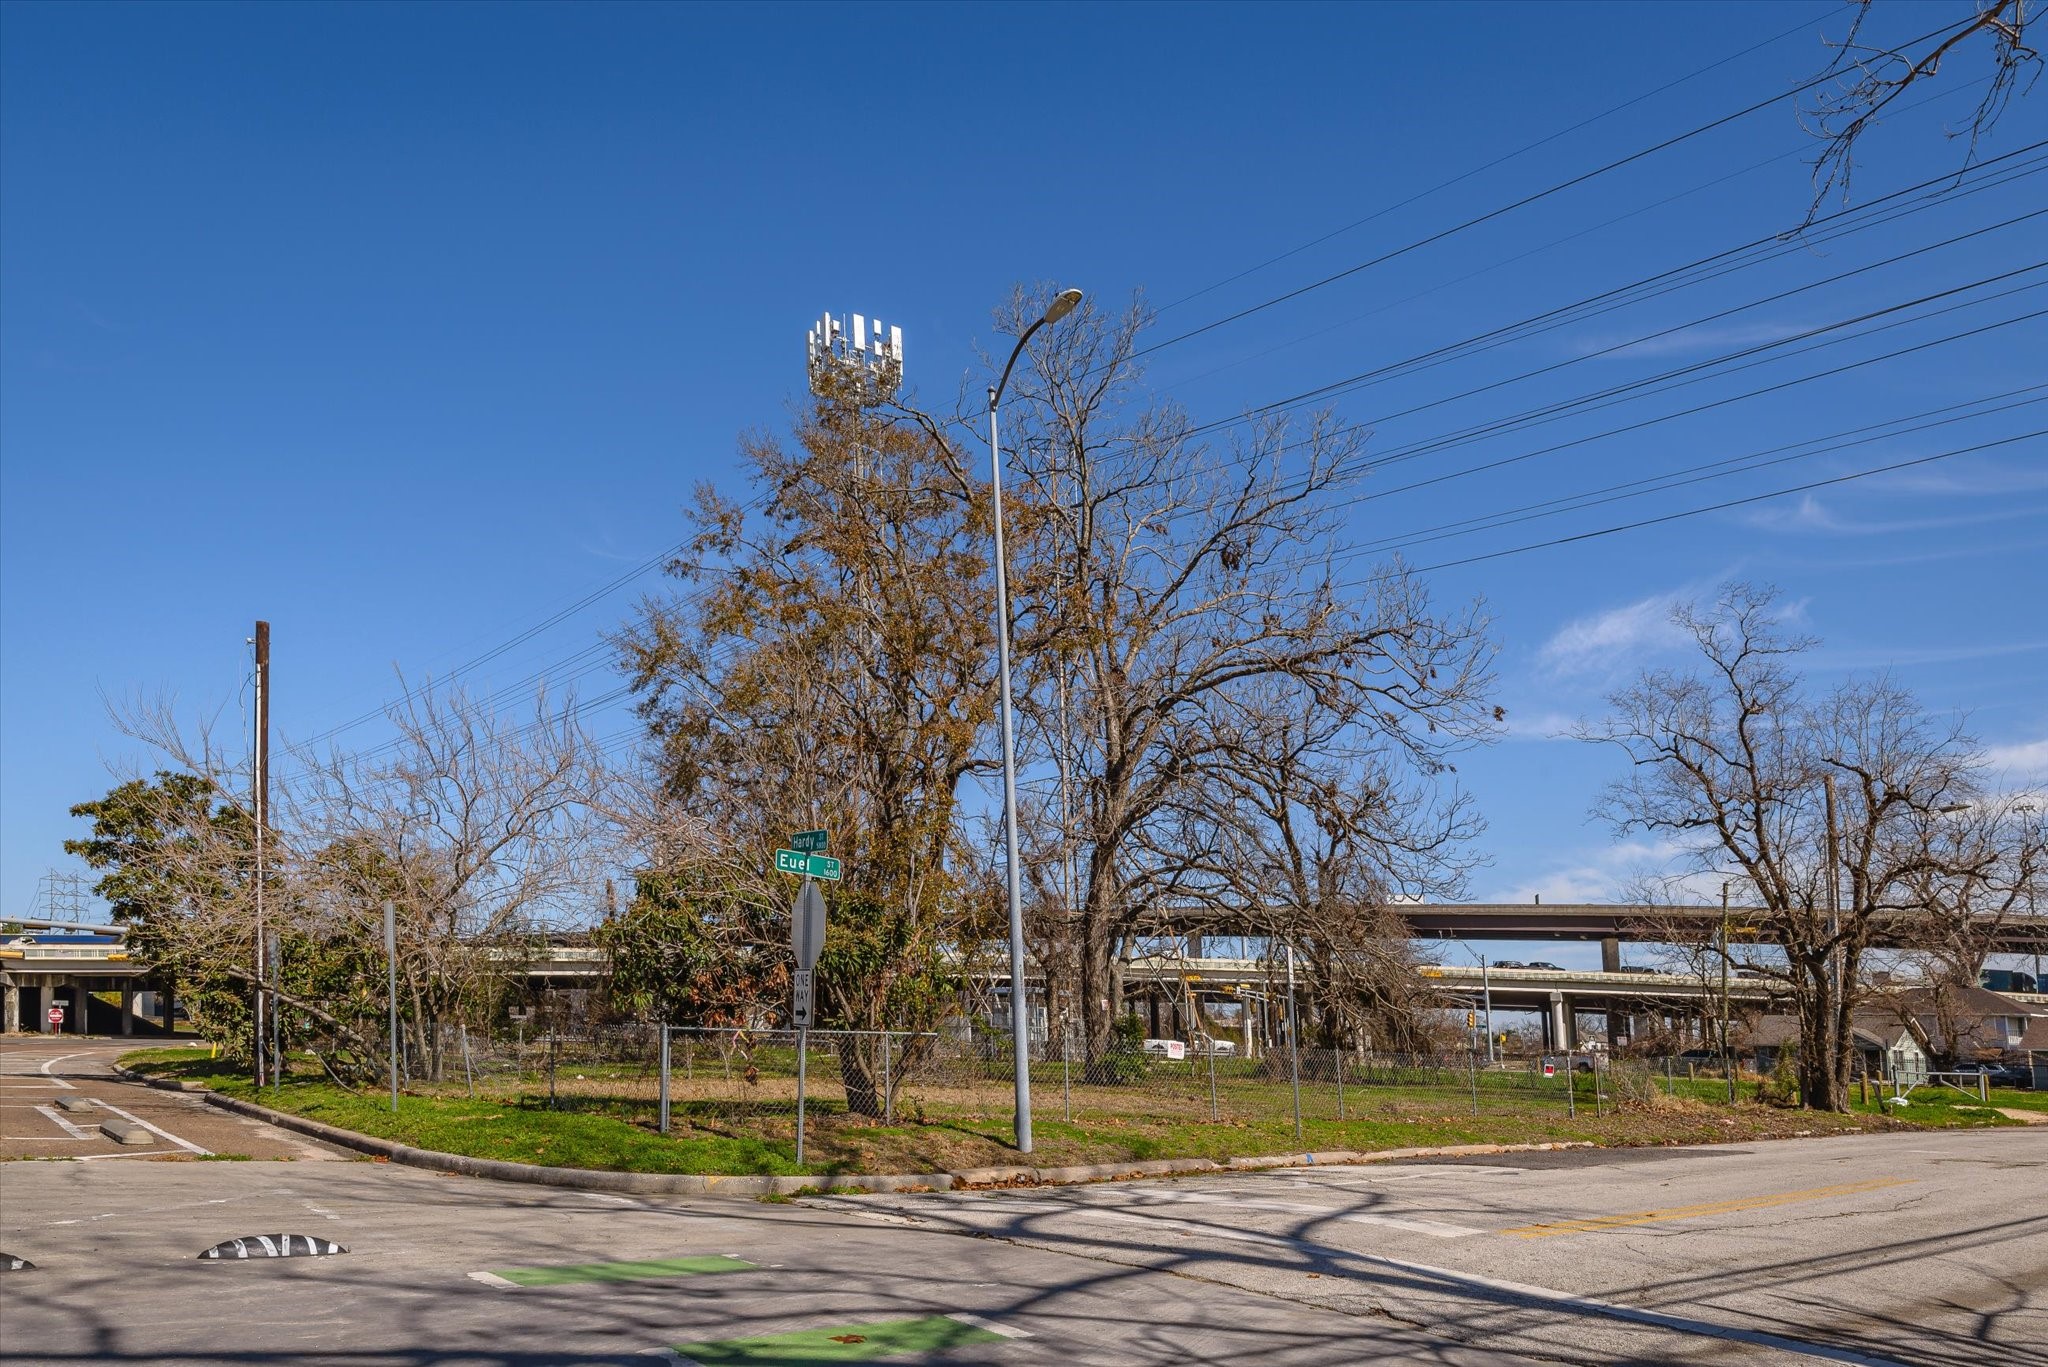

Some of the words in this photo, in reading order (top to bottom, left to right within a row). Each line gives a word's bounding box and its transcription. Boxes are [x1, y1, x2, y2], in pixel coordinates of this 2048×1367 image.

[793, 835, 815, 849] Hardy
[780, 854, 810, 871] Euel
[824, 868, 837, 877] 1600
[796, 974, 808, 986] ONE
[796, 990, 808, 1002] WAY
